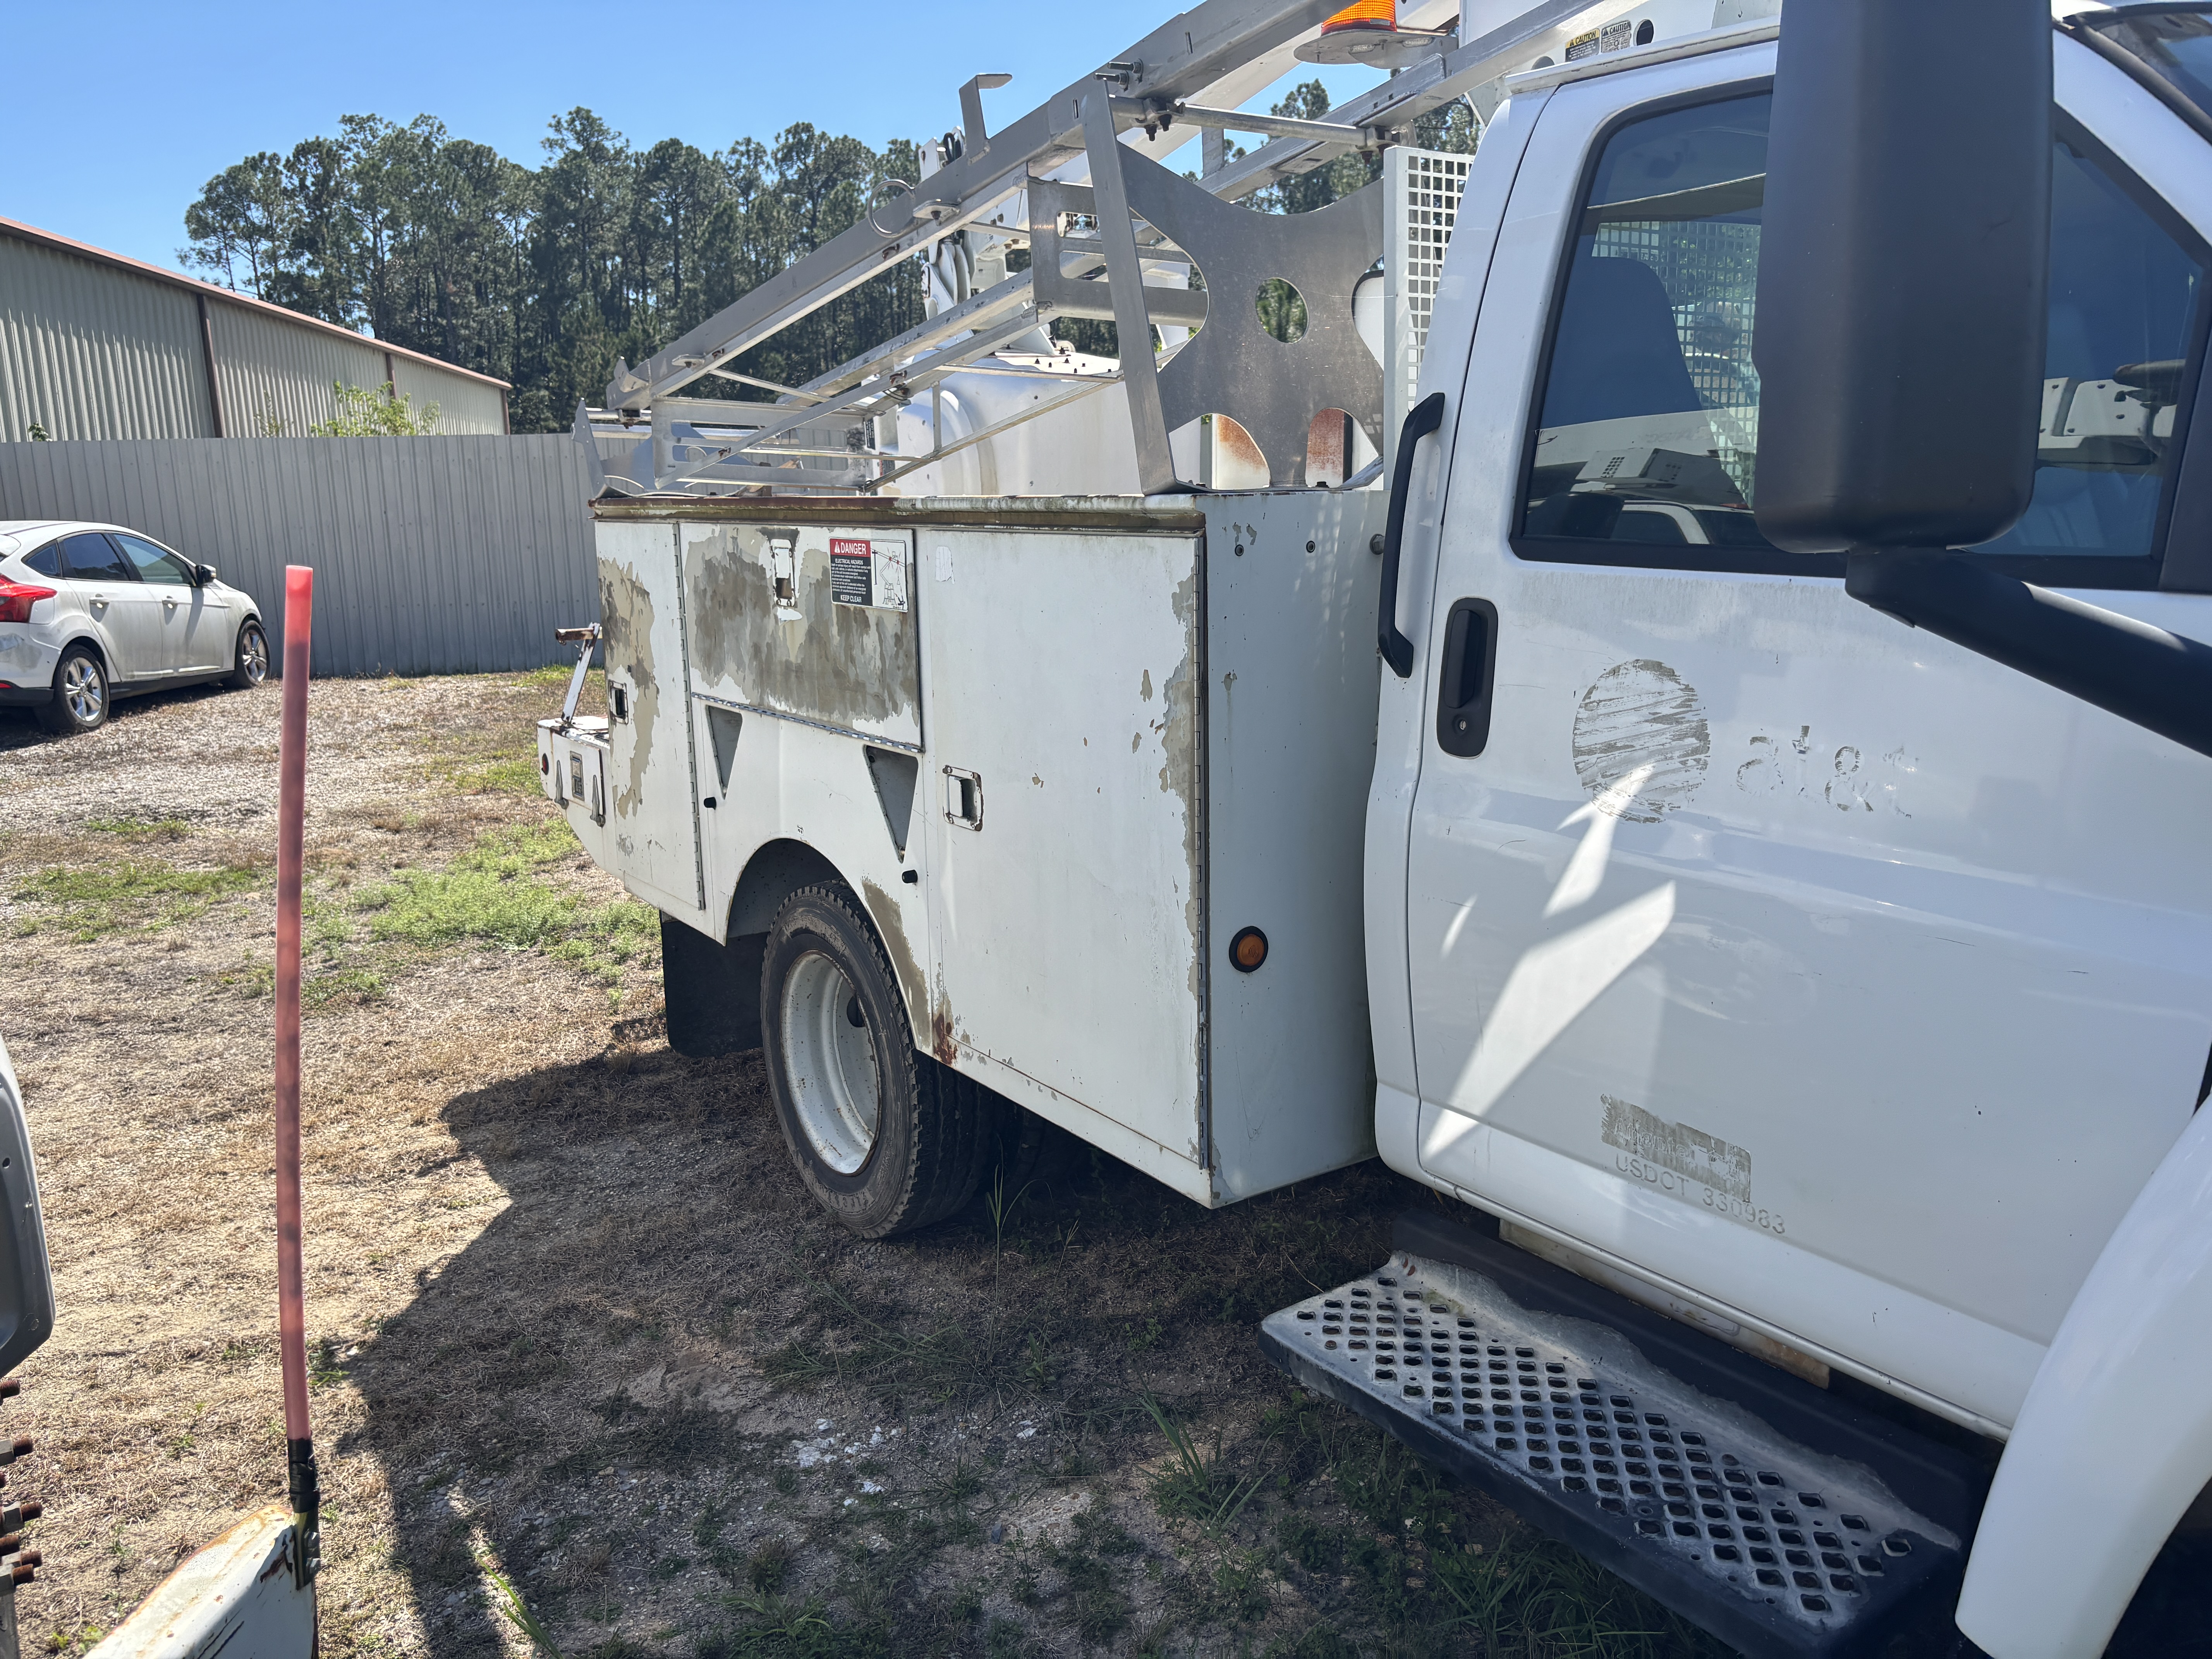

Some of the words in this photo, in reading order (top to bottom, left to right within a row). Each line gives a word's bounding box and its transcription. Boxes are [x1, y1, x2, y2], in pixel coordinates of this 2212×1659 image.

[1609, 21, 1631, 34] CAUTION
[1575, 30, 1596, 45] CAUTION
[841, 543, 866, 555] DANGER
[1616, 1154, 1689, 1196] USDOT
[1702, 1187, 1786, 1235] 330983
